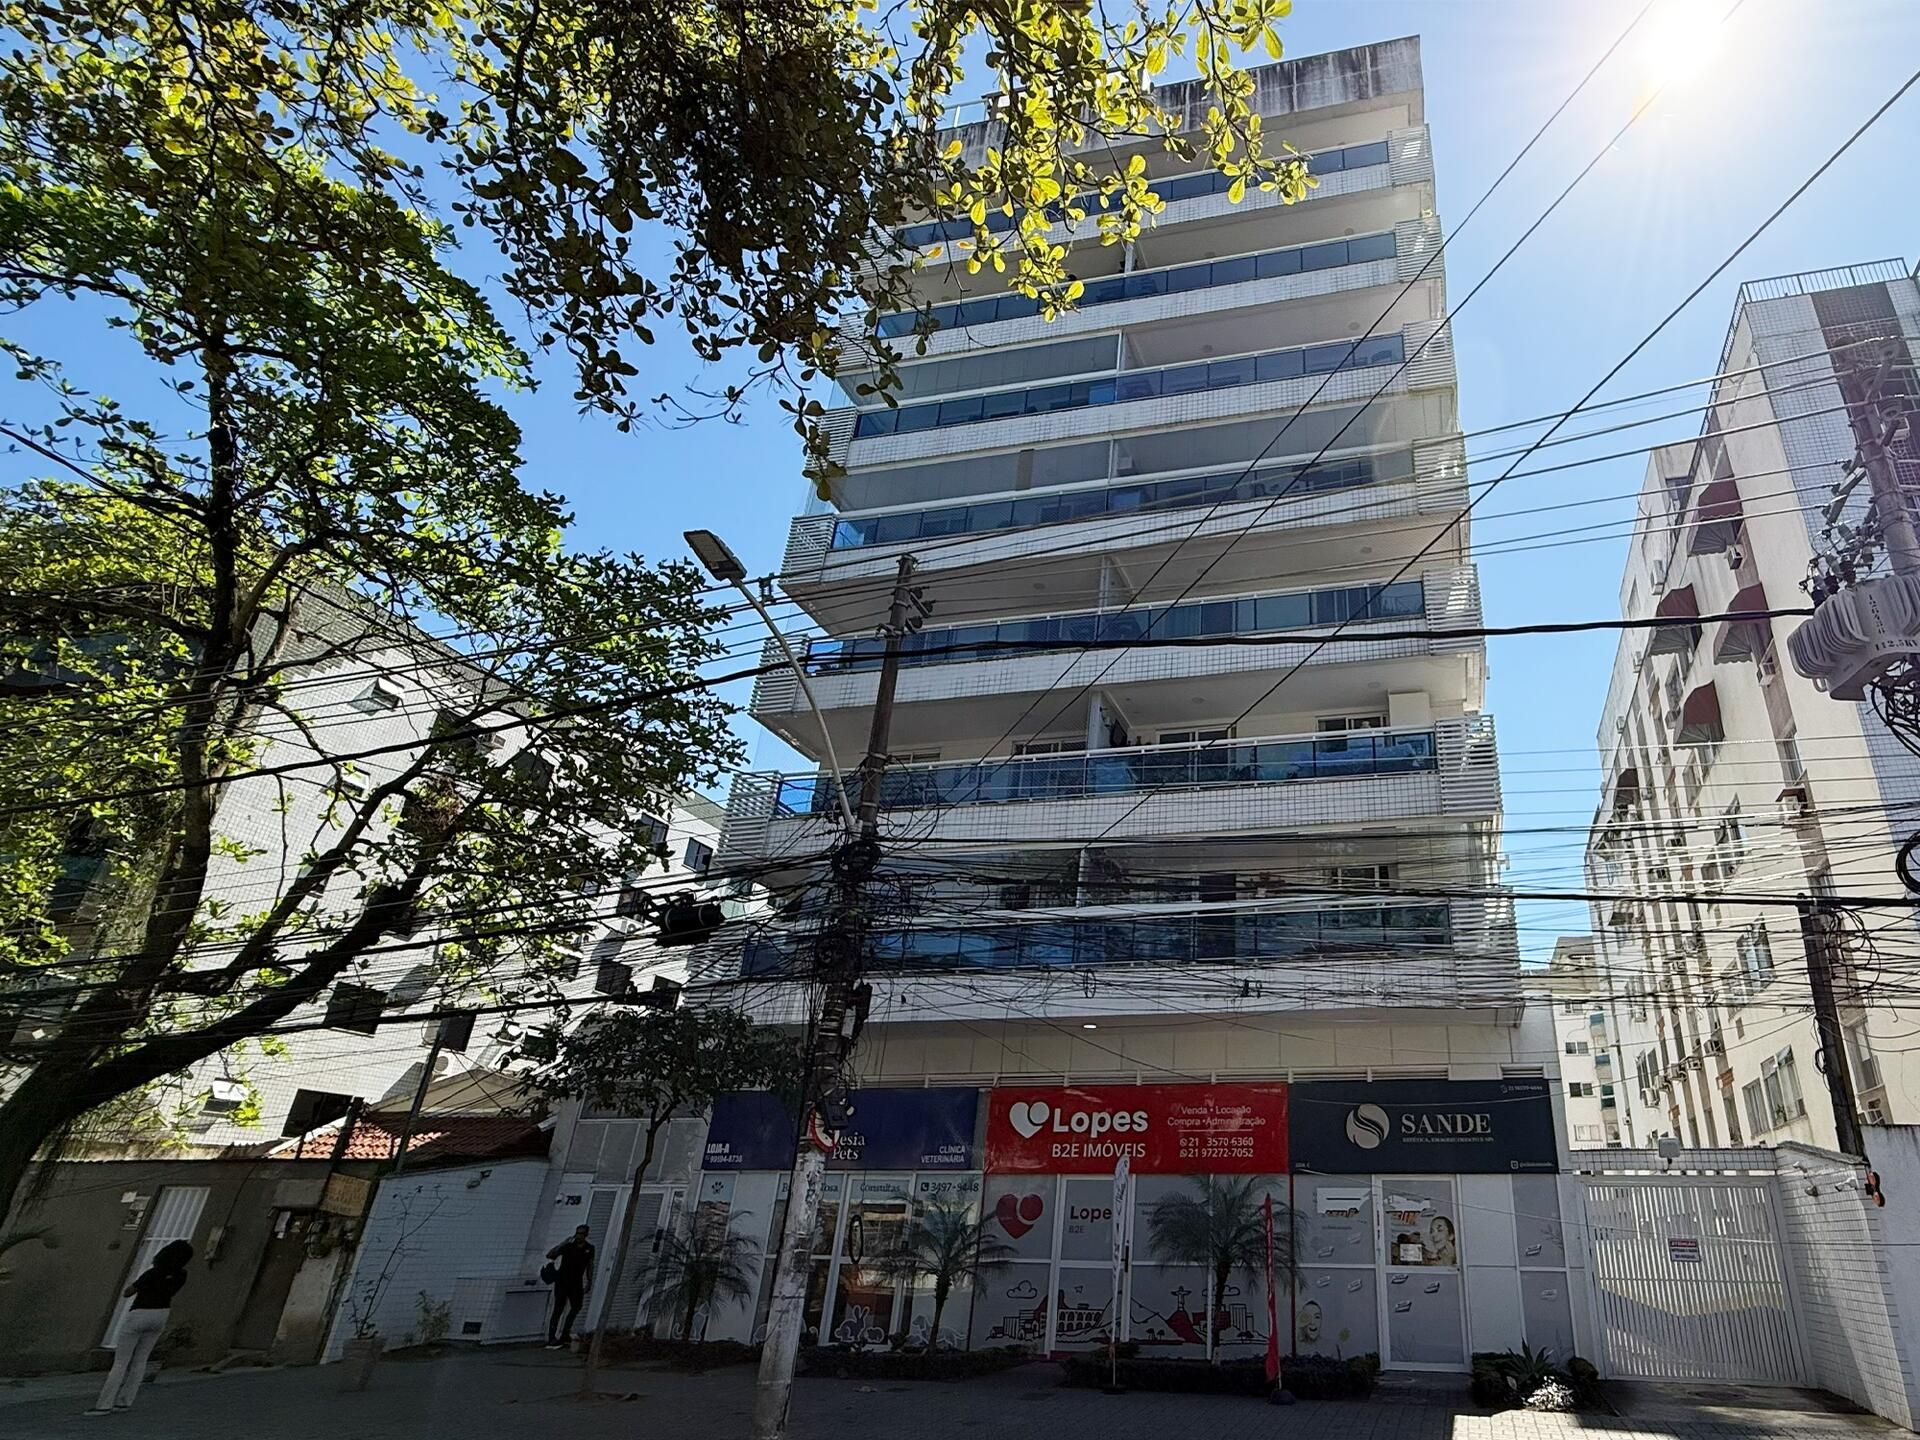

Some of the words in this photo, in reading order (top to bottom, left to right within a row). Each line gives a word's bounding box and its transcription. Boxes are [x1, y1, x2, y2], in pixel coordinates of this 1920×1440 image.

[1181, 1106, 1208, 1115] Venda
[1216, 1105, 1252, 1117] Locação
[1053, 1108, 1149, 1138] Lopes
[1167, 1117, 1201, 1127] Compra
[1401, 1113, 1492, 1134] SANDE
[1188, 1137, 1199, 1147] 21
[832, 1145, 859, 1160] Pets
[939, 1144, 966, 1154] CLÍNICA
[1052, 1143, 1079, 1158] B2E
[1083, 1140, 1146, 1158] IMÓVEIS
[1188, 1148, 1199, 1158] 21
[1201, 1148, 1254, 1158] 97272-7052
[920, 1153, 965, 1164] VETERINÁRIA
[860, 1182, 900, 1193] Consultas
[1070, 1206, 1112, 1223] Lope
